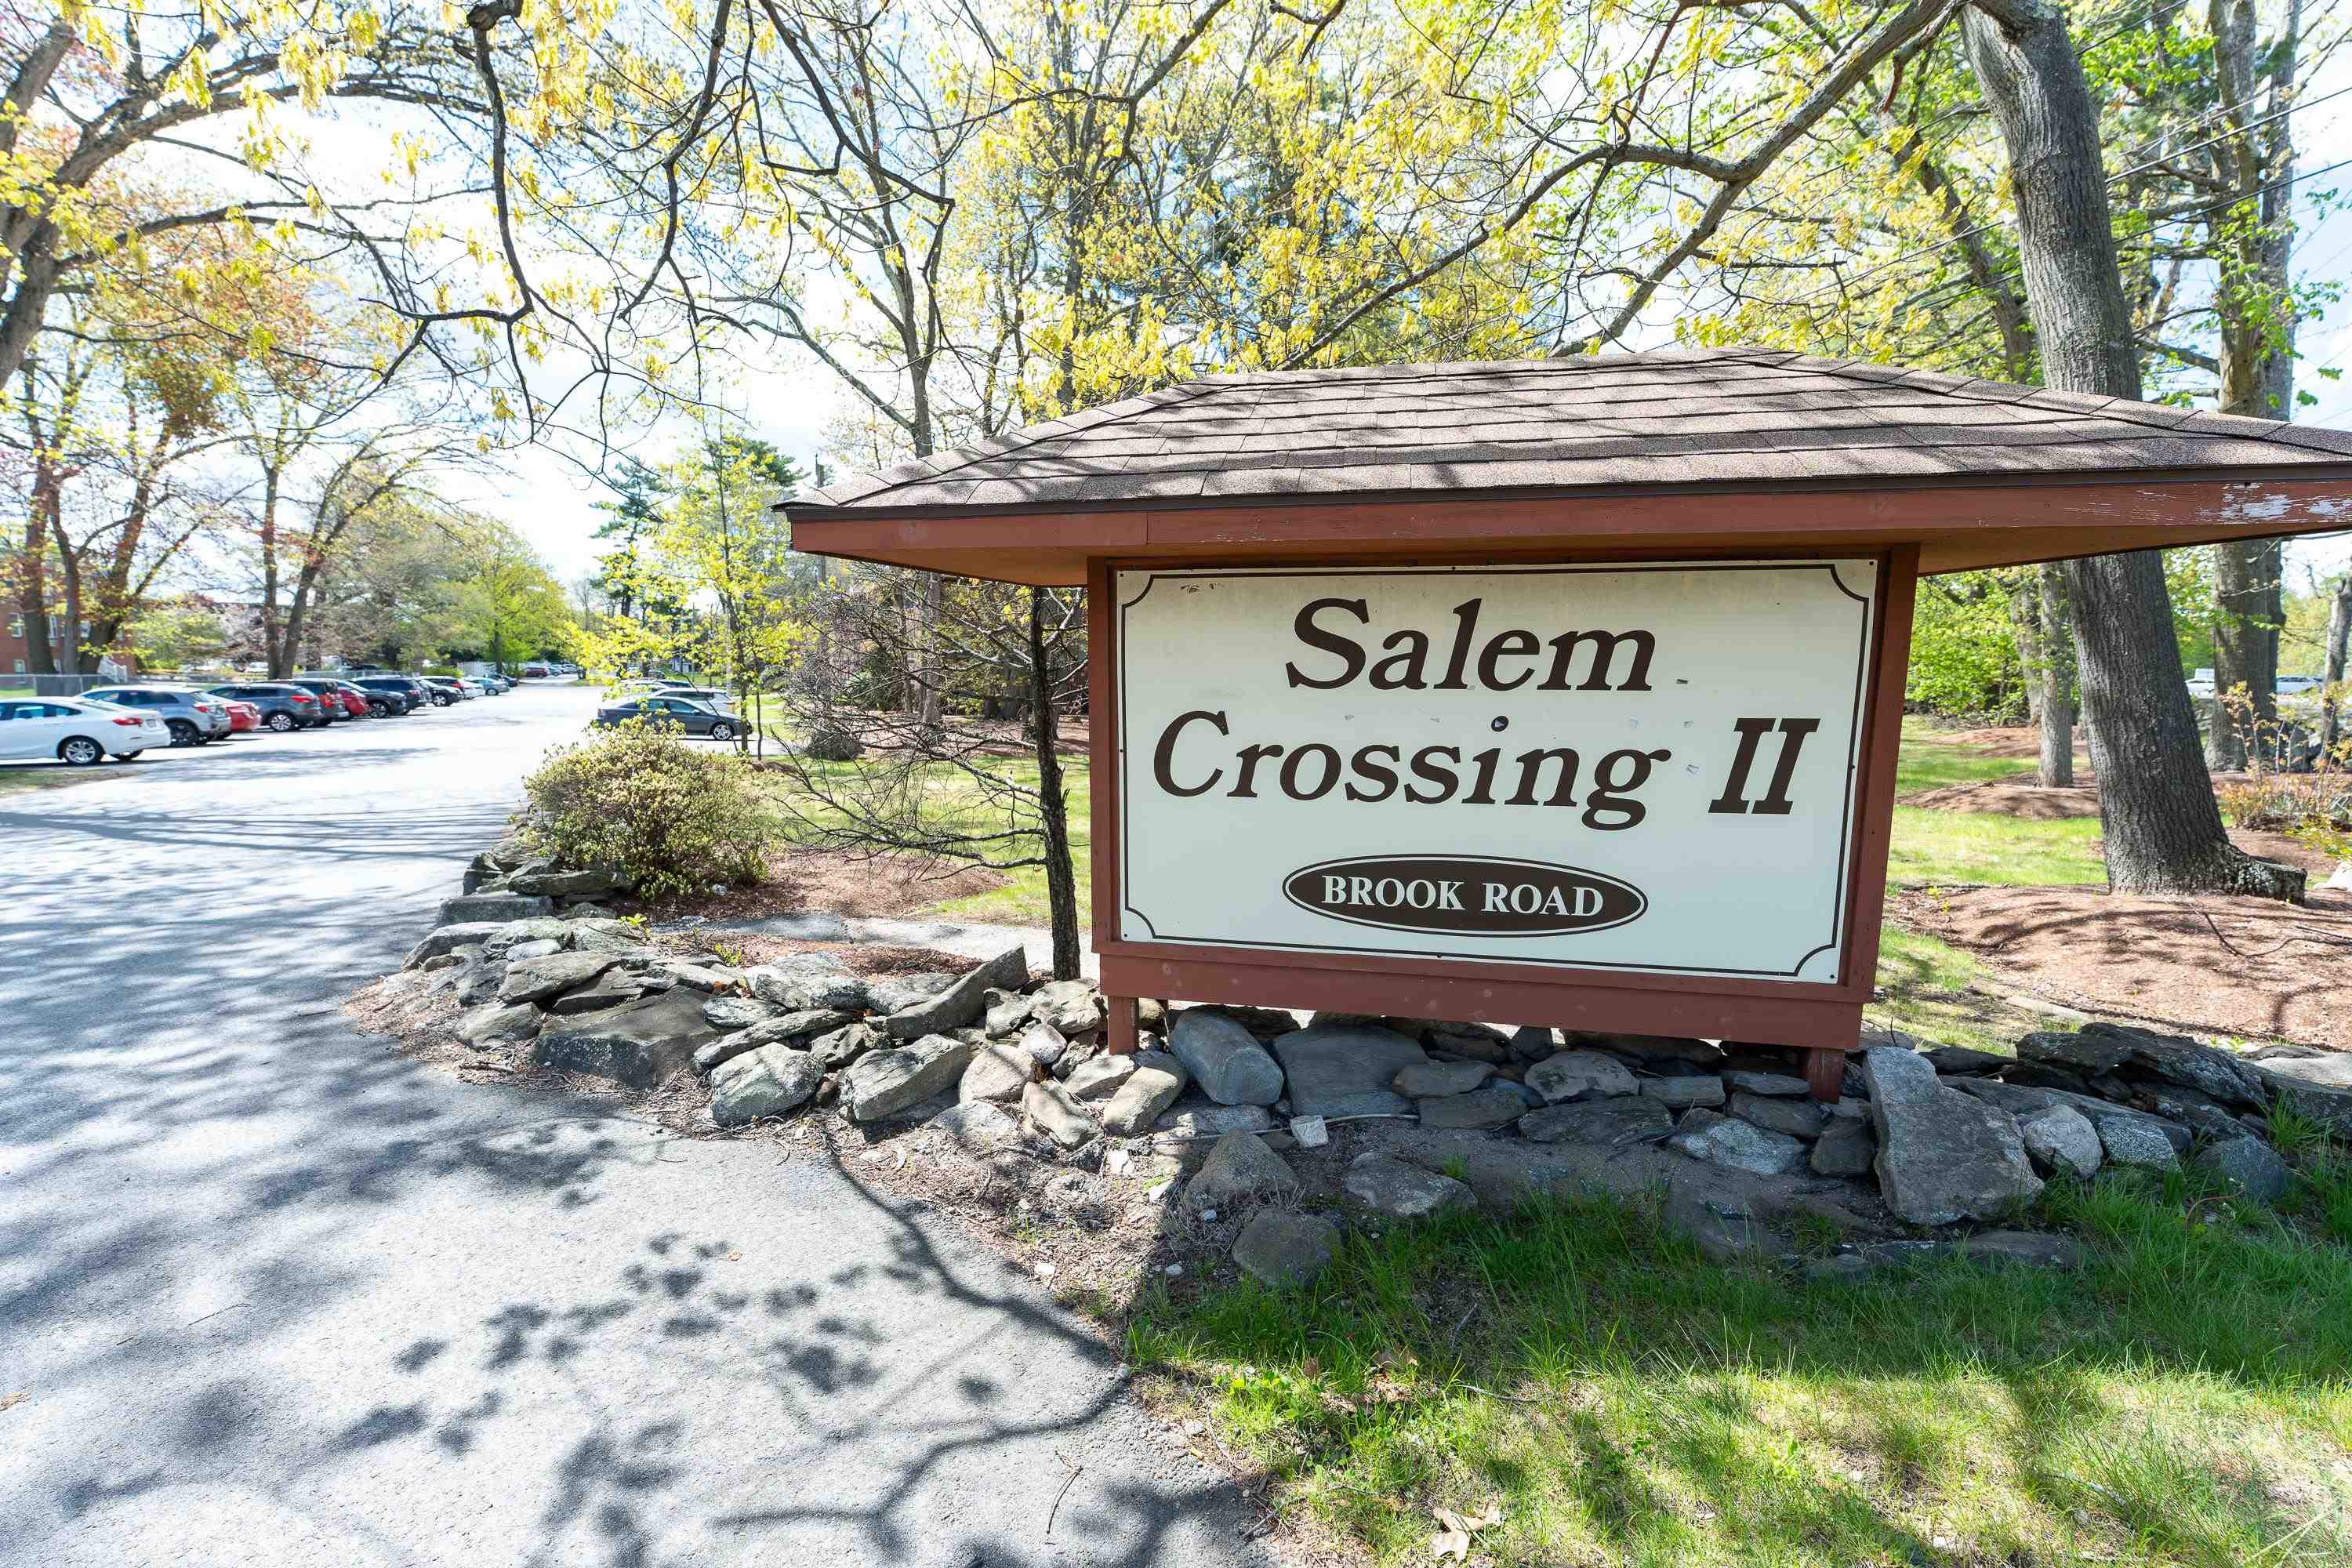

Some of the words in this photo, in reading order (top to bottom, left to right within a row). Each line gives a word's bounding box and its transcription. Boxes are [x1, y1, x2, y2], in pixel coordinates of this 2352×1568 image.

[1286, 597, 1657, 692] Salem
[1152, 710, 1672, 831] Crossing
[1707, 717, 1820, 815] II
[1321, 874, 1465, 911] BROOK
[1482, 881, 1604, 917] ROAD
